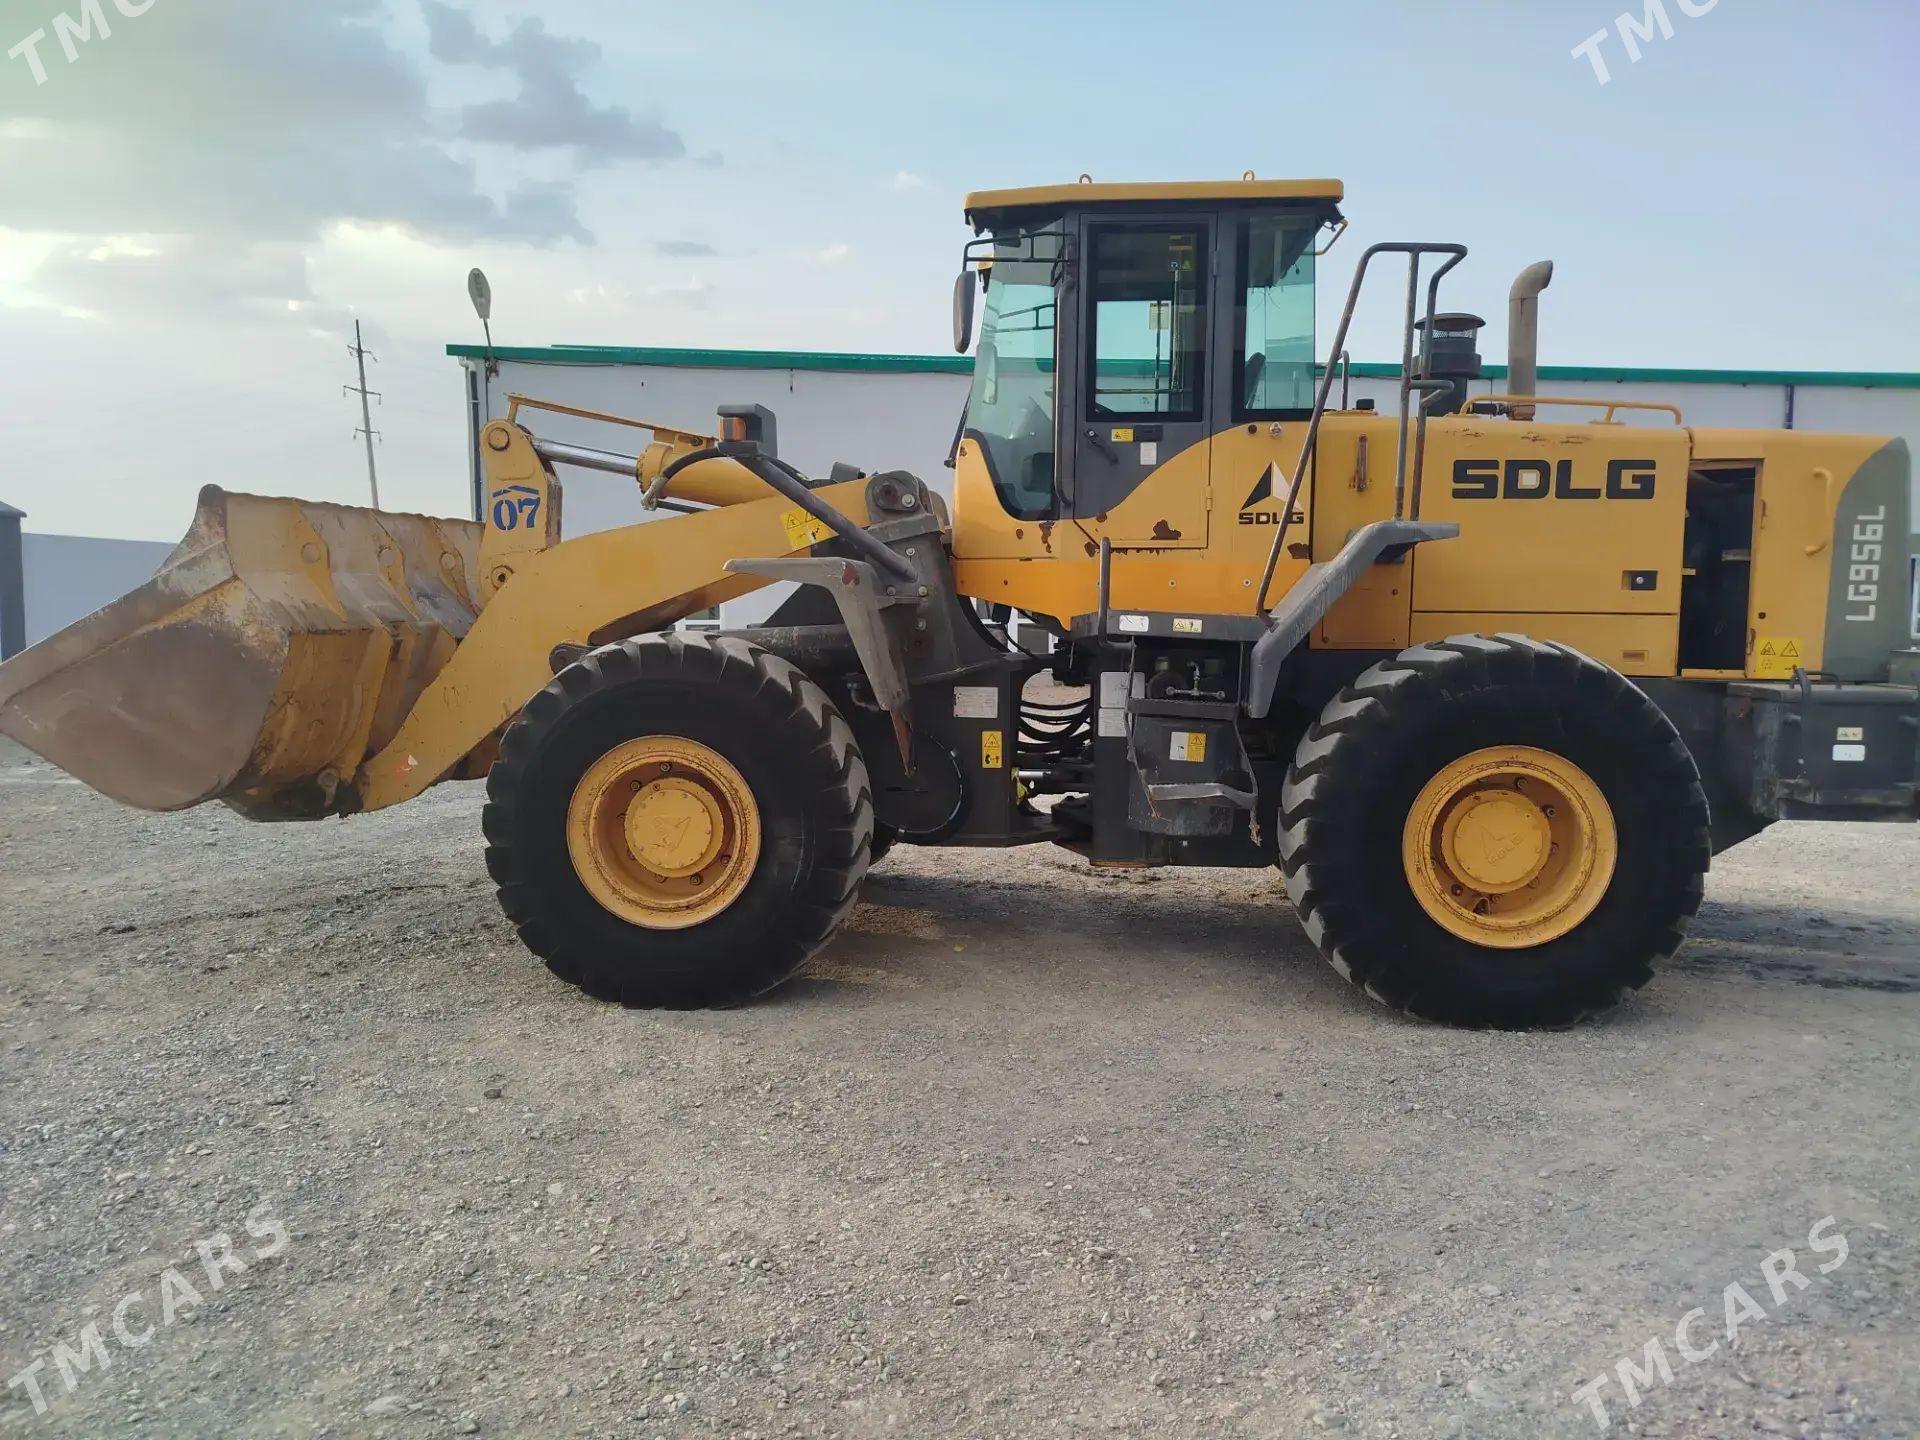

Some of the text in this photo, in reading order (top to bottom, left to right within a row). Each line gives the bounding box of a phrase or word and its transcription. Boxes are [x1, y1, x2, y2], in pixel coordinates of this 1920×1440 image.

[1452, 459, 1656, 499] SDLG
[493, 496, 541, 531] 07
[1238, 511, 1304, 525] SDLG
[1845, 505, 1885, 621] LG956L
